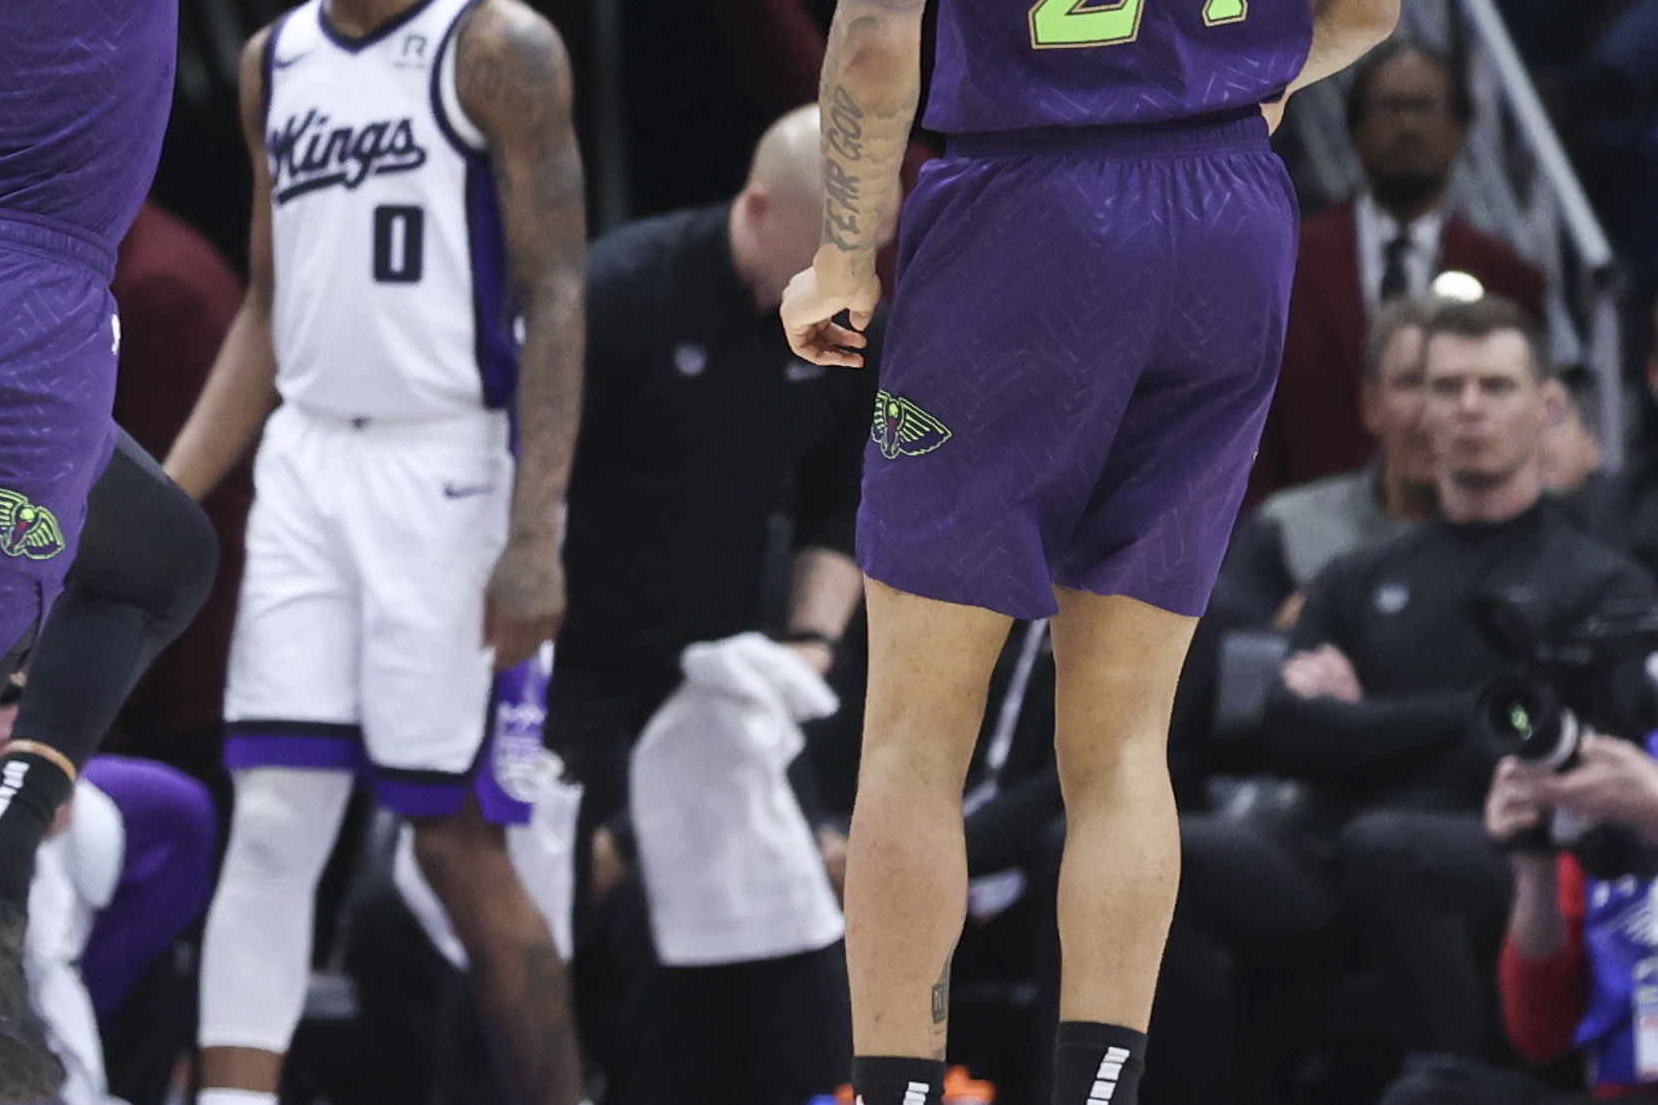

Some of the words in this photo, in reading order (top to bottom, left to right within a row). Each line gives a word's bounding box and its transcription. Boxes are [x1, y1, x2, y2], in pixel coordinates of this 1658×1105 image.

[271, 107, 427, 204] Kings
[828, 84, 864, 161] GOD
[374, 204, 423, 283] 0
